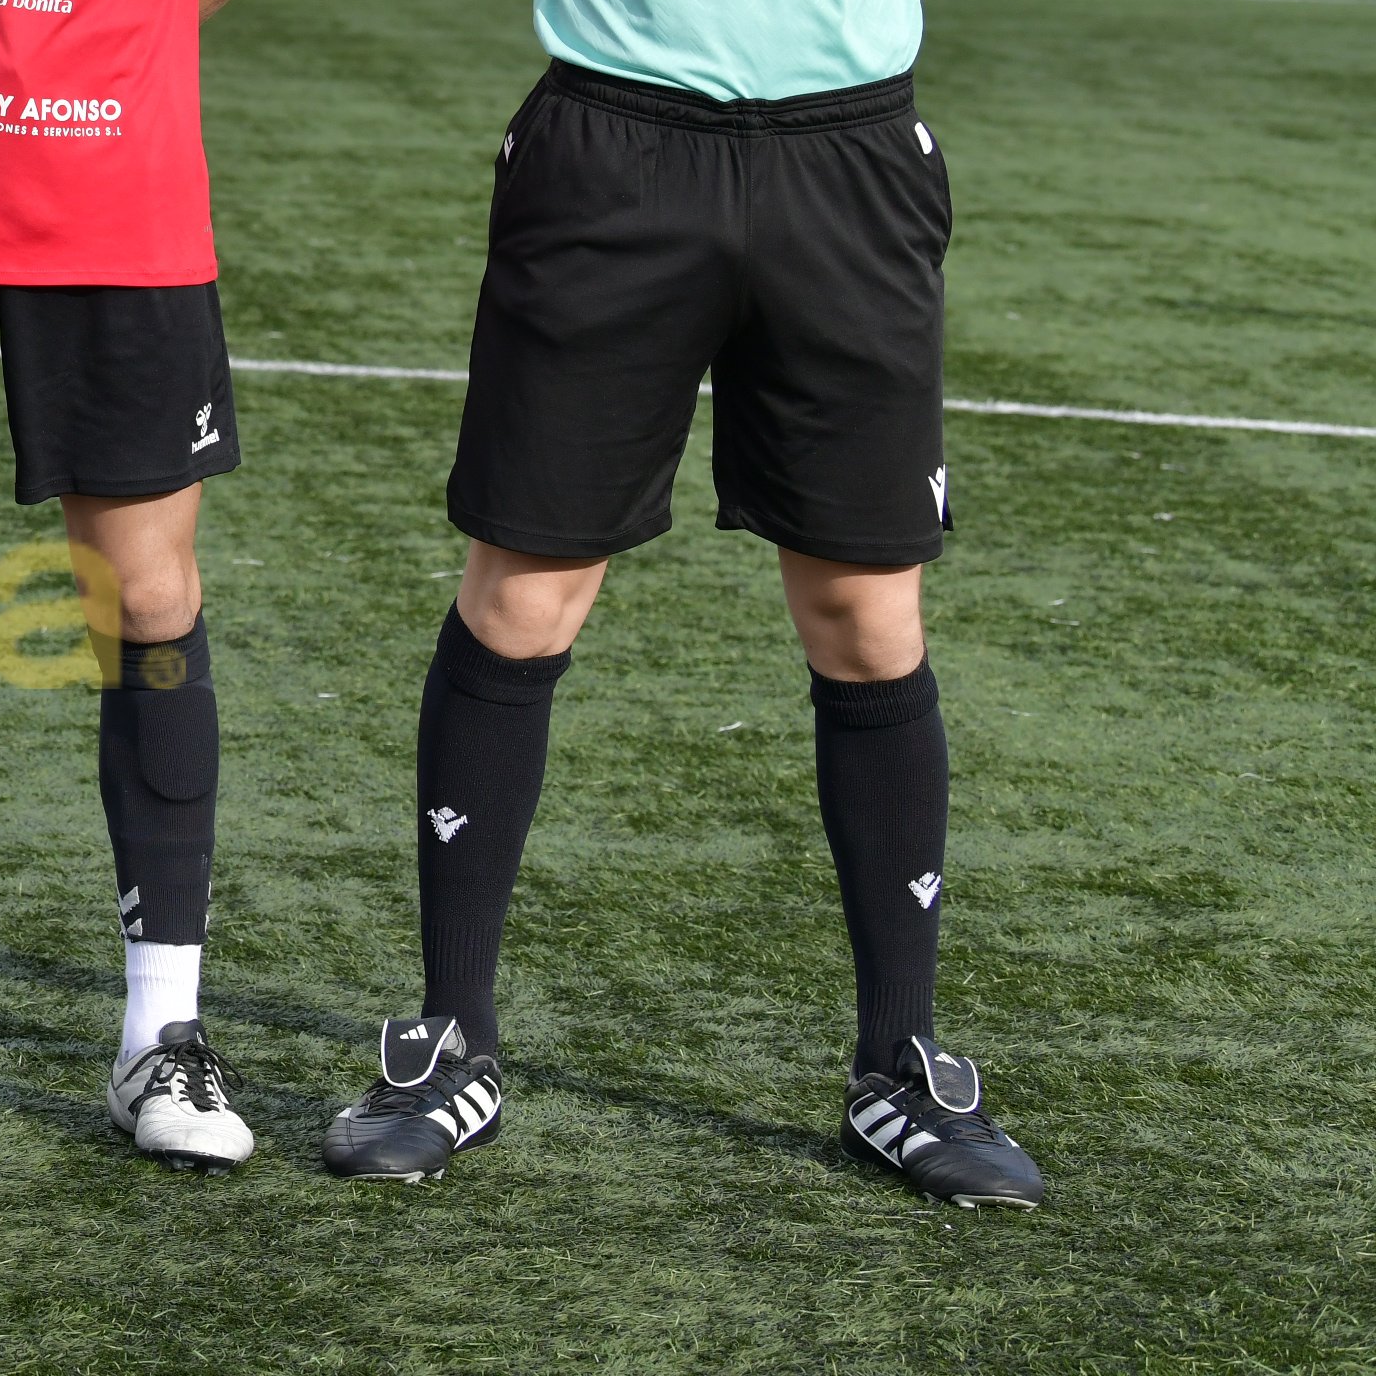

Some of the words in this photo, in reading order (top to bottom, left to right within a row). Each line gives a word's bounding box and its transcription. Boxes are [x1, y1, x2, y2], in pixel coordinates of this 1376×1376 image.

[20, 97, 122, 122] AFONSO
[31, 127, 39, 136] &
[43, 126, 101, 137] SERVICIOS
[191, 428, 220, 455] hummel
